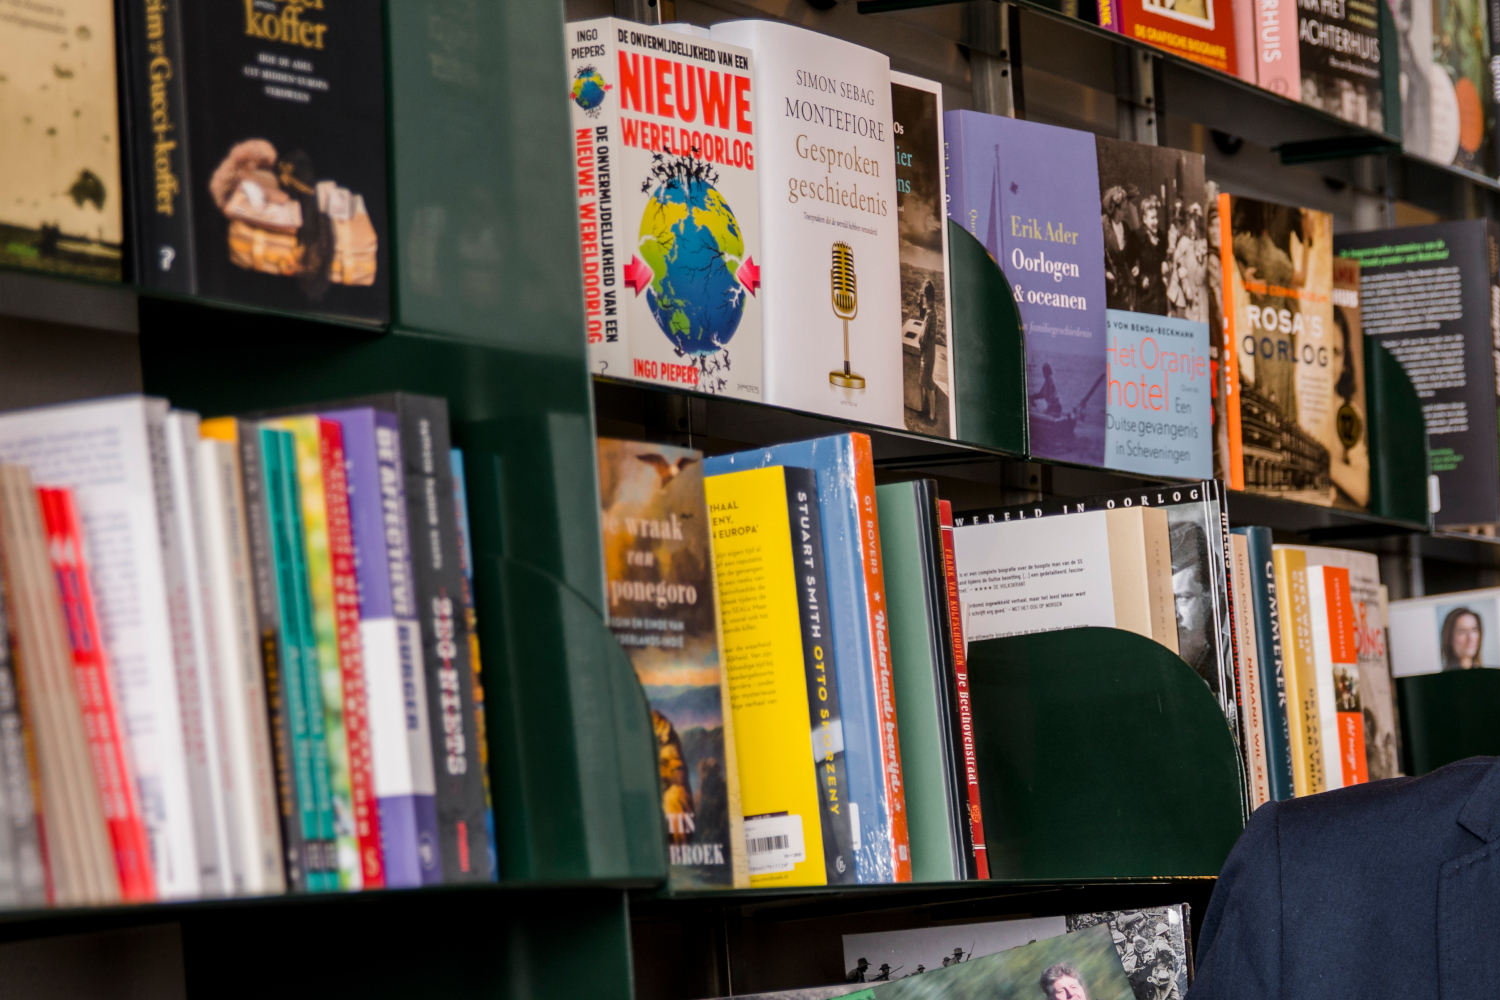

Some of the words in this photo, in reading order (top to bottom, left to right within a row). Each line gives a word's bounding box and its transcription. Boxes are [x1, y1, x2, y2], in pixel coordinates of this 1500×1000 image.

[245, 2, 328, 49] koffer
[577, 28, 598, 43] INGO
[1300, 18, 1381, 63] ACHTERHUIS
[259, 54, 276, 65] HOE
[279, 57, 290, 67] DE
[571, 45, 605, 60] PIEPERS
[617, 28, 629, 44] DE
[630, 31, 716, 63] ONVERMIJDELIJKHEID
[717, 51, 733, 67] VAN
[735, 55, 749, 71] EEN
[618, 49, 753, 135] NIEUWE
[796, 69, 837, 95] SIMON
[840, 81, 875, 106] SEBAG
[150, 57, 180, 217] Gucci-koffer
[595, 126, 608, 142] DE
[785, 97, 886, 143] MONTEFIORE
[576, 128, 596, 198] NIEUWE
[620, 116, 755, 171] WERELDOORLOG
[795, 134, 880, 178] Gesproken
[597, 146, 615, 287] ONVERMIJDELIJKHEID
[788, 176, 888, 217] geschiedenis
[1010, 215, 1043, 240] Erik
[1044, 221, 1079, 246] Ader
[579, 201, 604, 344] WERELDOORLOG
[1011, 248, 1080, 283] Oorlogen
[604, 290, 617, 316] VAN
[1013, 284, 1025, 302] &
[1027, 288, 1087, 311] oceanen
[605, 319, 618, 343] EEN
[1113, 321, 1129, 331] VON
[1130, 324, 1195, 339] BENDA-BECKMANN
[1245, 304, 1324, 339] ROSA'S
[633, 358, 657, 380] INGO
[660, 363, 700, 386] PIEPERS
[1106, 336, 1137, 368] Het
[1140, 337, 1206, 381] Oranje
[1242, 335, 1329, 368] OORLOG
[1107, 363, 1169, 412] hotel
[1175, 397, 1192, 415] Een
[1106, 413, 1137, 433] Duitse
[1138, 420, 1199, 441] gevangenis
[1115, 442, 1125, 457] in
[1126, 440, 1191, 465] Scheveningen
[864, 495, 873, 515] GT
[955, 508, 1042, 528] WERELD
[1063, 503, 1086, 516] IN
[1106, 489, 1199, 511] OORLOG
[379, 463, 412, 619] AFFECTIEVE
[625, 513, 684, 541] wraak
[719, 524, 759, 540] EUROPA'
[798, 491, 815, 569] STUART
[866, 520, 879, 576] ROVERS
[945, 548, 955, 578] FRANK
[949, 581, 958, 598] VAN
[1238, 553, 1246, 590] LINDA
[806, 575, 822, 639] SMITH
[1241, 592, 1251, 647] POLMAN
[950, 600, 965, 666] KOLFSCHOOTEN
[1265, 560, 1287, 708] GEMMEKER
[813, 645, 828, 702] OTTO
[874, 609, 894, 720] Nederland
[957, 672, 967, 688] De
[1247, 656, 1259, 729] NIEMAND
[885, 720, 900, 794] bevrijd
[959, 691, 978, 786] Beethovenstraat
[819, 708, 840, 816] SKORZENY
[1256, 764, 1263, 781] ZE
